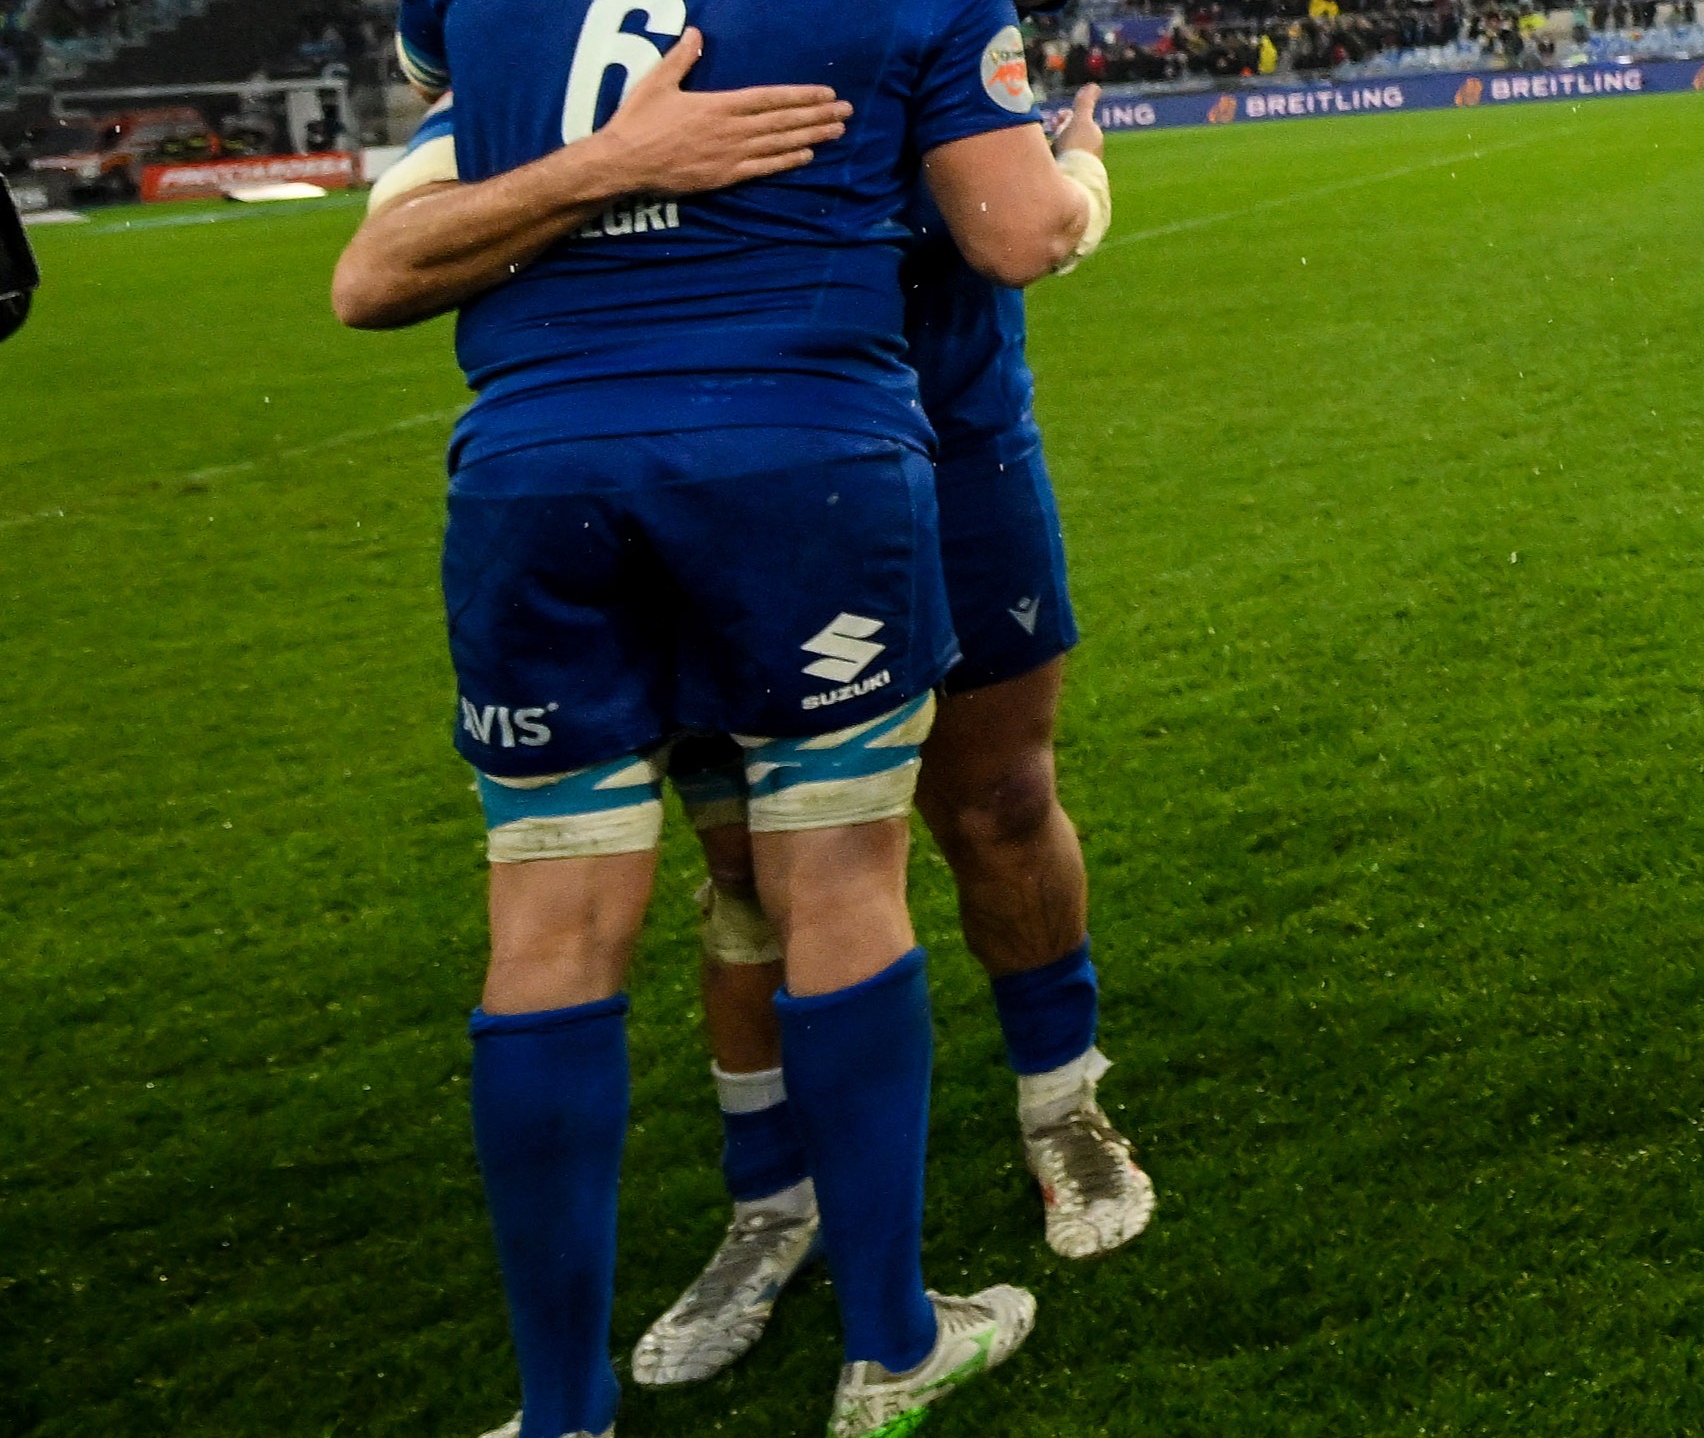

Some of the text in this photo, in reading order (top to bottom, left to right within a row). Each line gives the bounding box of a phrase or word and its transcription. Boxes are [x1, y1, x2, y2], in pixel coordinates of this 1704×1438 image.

[1246, 86, 1404, 118] BREITLING
[1490, 69, 1642, 100] BREITLING
[801, 669, 892, 711] SUZUKI
[461, 696, 552, 748] AVIS
